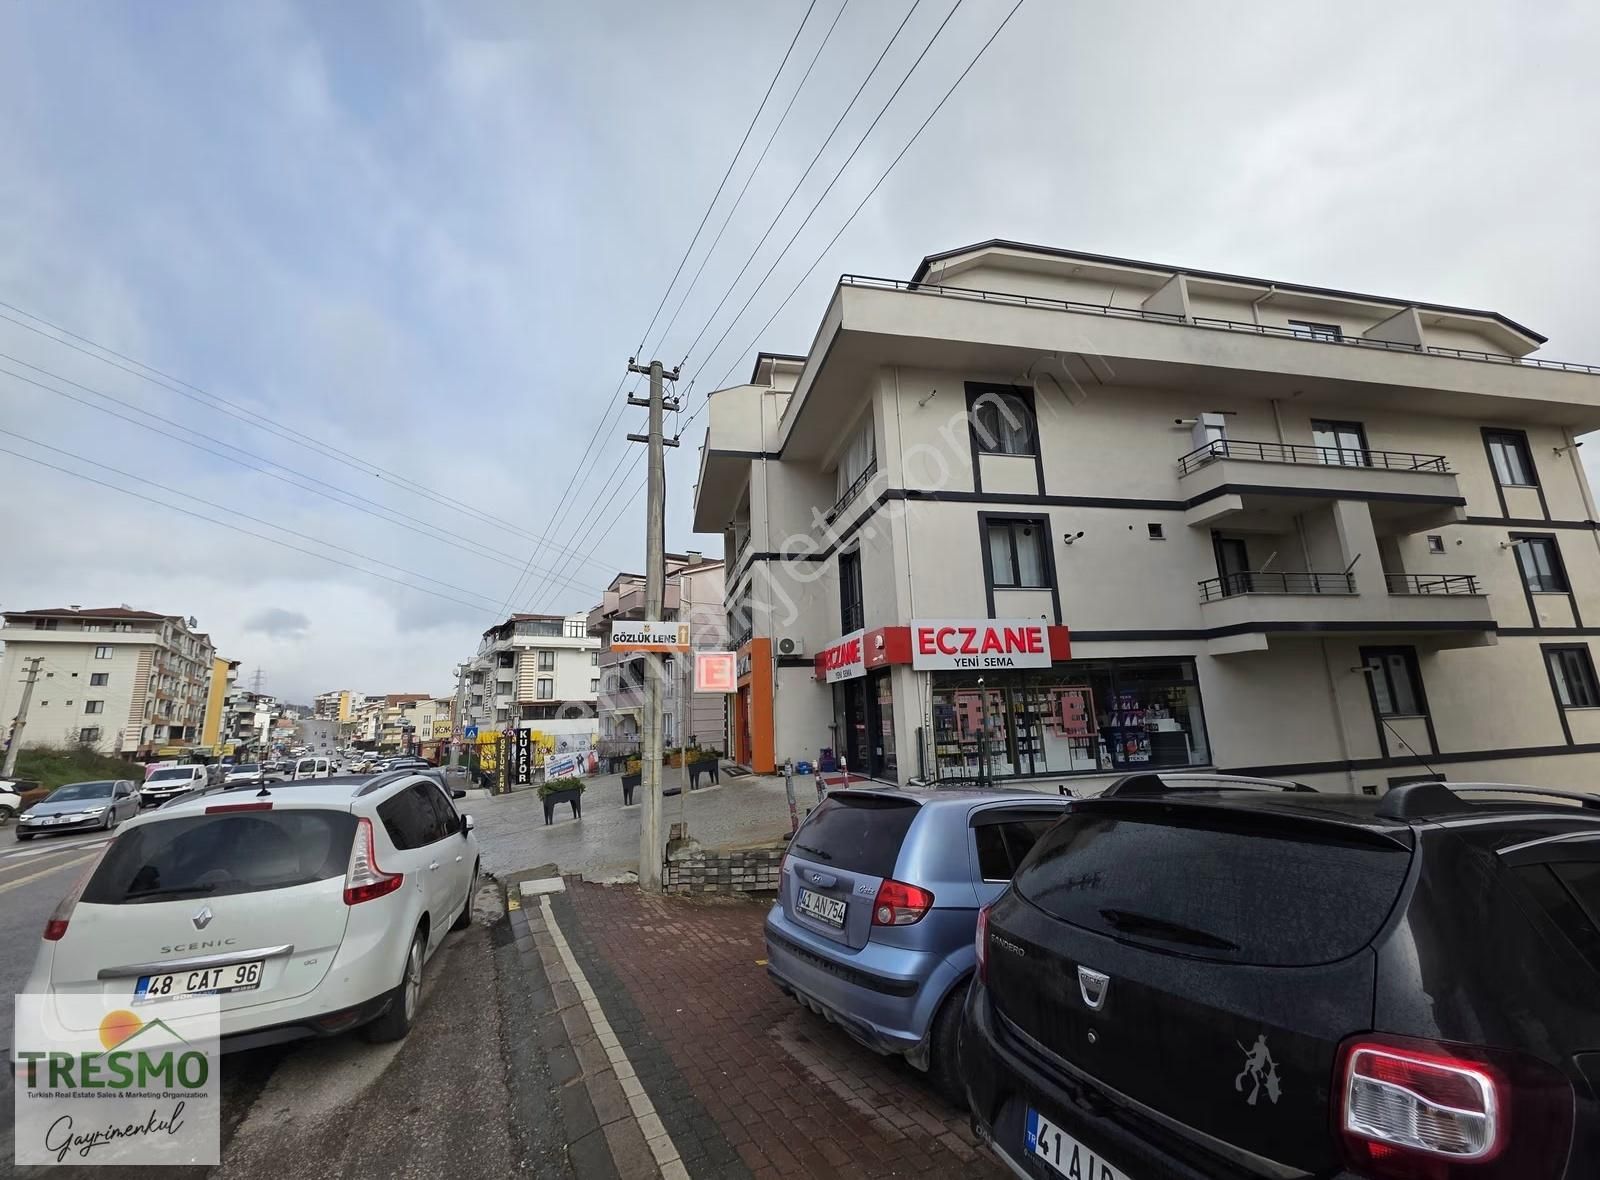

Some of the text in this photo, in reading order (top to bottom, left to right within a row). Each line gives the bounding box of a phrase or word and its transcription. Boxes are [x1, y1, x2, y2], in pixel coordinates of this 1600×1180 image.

[613, 632, 677, 644] GÖZLÜK LENS
[918, 627, 1045, 655] ECZANE
[825, 638, 861, 671] ECZANE
[954, 655, 1014, 667] YENİ SEMA
[801, 889, 811, 908] 41
[813, 895, 827, 913] AN
[828, 900, 845, 921] 754
[160, 938, 237, 954] SCENIC
[991, 933, 1025, 957] SANDERO
[148, 976, 174, 995] 48
[186, 969, 223, 991] CAT
[234, 965, 259, 984] 96
[1027, 1130, 1036, 1145] TR
[1037, 1123, 1061, 1166] 41
